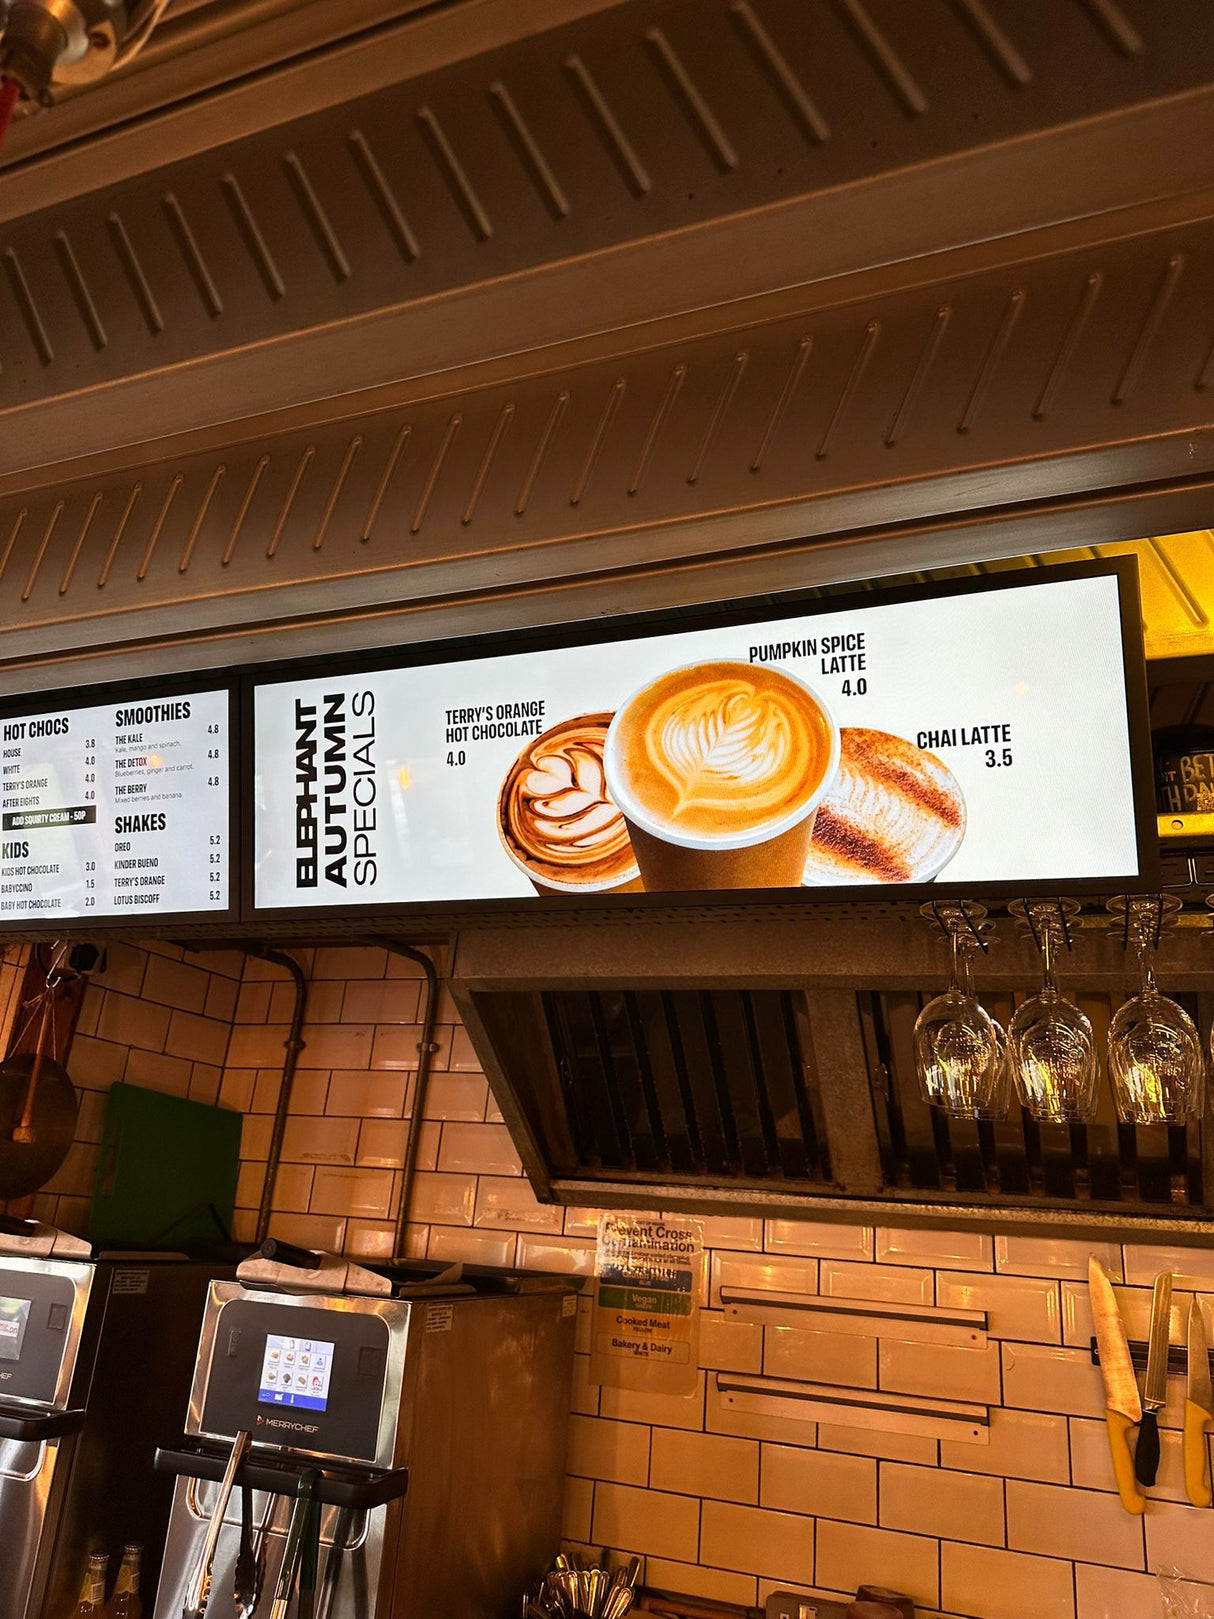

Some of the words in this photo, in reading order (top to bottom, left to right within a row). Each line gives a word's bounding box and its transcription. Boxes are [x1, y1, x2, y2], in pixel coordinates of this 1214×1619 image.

[749, 638, 817, 663] PUMPKIN
[821, 633, 865, 654] SPICE
[821, 654, 866, 675] LATTE
[841, 678, 867, 697] 4.0
[115, 701, 191, 728] SMOOTHIES
[445, 705, 493, 726] TERRY'S
[496, 700, 545, 720] ORANGE
[4, 723, 26, 741] HOT
[29, 717, 69, 738] CHOCS
[207, 724, 219, 734] 4.8
[446, 726, 468, 743] HOT
[472, 719, 543, 741] CHOCOLATE
[115, 735, 127, 745] THE
[128, 733, 143, 744] KALE
[917, 729, 957, 750] CHAI
[961, 724, 1011, 746] LATTE
[85, 739, 95, 748] 3.8
[3, 748, 21, 758] HOUSE
[207, 749, 219, 759] 4.8
[446, 750, 466, 766] 4.0
[985, 748, 1013, 768] 3.5
[85, 756, 95, 765] 4.0
[115, 759, 126, 769] THE
[127, 757, 147, 768] DETOX
[3, 765, 20, 775] WHITE
[85, 773, 95, 782] 4.0
[208, 776, 219, 786] 4.8
[3, 780, 25, 791] TERRY'S
[25, 778, 48, 790] ORANGE
[115, 785, 126, 795] THE
[127, 783, 147, 794] BERRY
[323, 693, 347, 888] AUTUMN
[352, 690, 377, 886] SPECIALS
[85, 790, 95, 799] 4.0
[295, 698, 318, 888] ELEPHANT
[3, 798, 19, 808] AFTER
[20, 796, 40, 806] EIGHTS
[12, 815, 24, 826] ADD
[25, 814, 49, 825] SQUIRTY
[49, 812, 70, 823] CREAM
[73, 811, 86, 821] 50P
[115, 813, 166, 834] SHAKES
[209, 835, 220, 845] 5.2
[2, 841, 29, 859] KIDS
[114, 842, 131, 852] OREO
[114, 859, 137, 870] KINDER
[137, 858, 159, 868] BUENO
[209, 853, 220, 863] 5.2
[2, 867, 14, 876] KIDS
[15, 866, 26, 876] HOT
[27, 864, 60, 875] CHOCOLATE
[85, 862, 95, 871] 3.0
[114, 877, 139, 887] TERRY'S
[139, 875, 165, 886] ORANGE
[209, 872, 220, 882] 5.2
[1, 883, 32, 893] BABYCCINO
[86, 879, 95, 889] 1.5
[114, 895, 133, 905] LOTUS
[134, 894, 160, 904] BISCOFF
[209, 890, 220, 900] 5.2
[1, 901, 16, 911] BABY
[17, 900, 27, 910] HOT
[29, 898, 61, 909] CHOCOLATE
[85, 897, 95, 906] 2.0
[656, 1226, 693, 1240] Cross
[631, 1293, 657, 1305] Vegan
[616, 1315, 647, 1327] Cooked
[649, 1319, 670, 1330] Meat
[612, 1338, 640, 1351] Bakery
[642, 1343, 648, 1351] &
[650, 1343, 672, 1355] Dairy
[265, 1418, 319, 1433] MERRYCHEF
